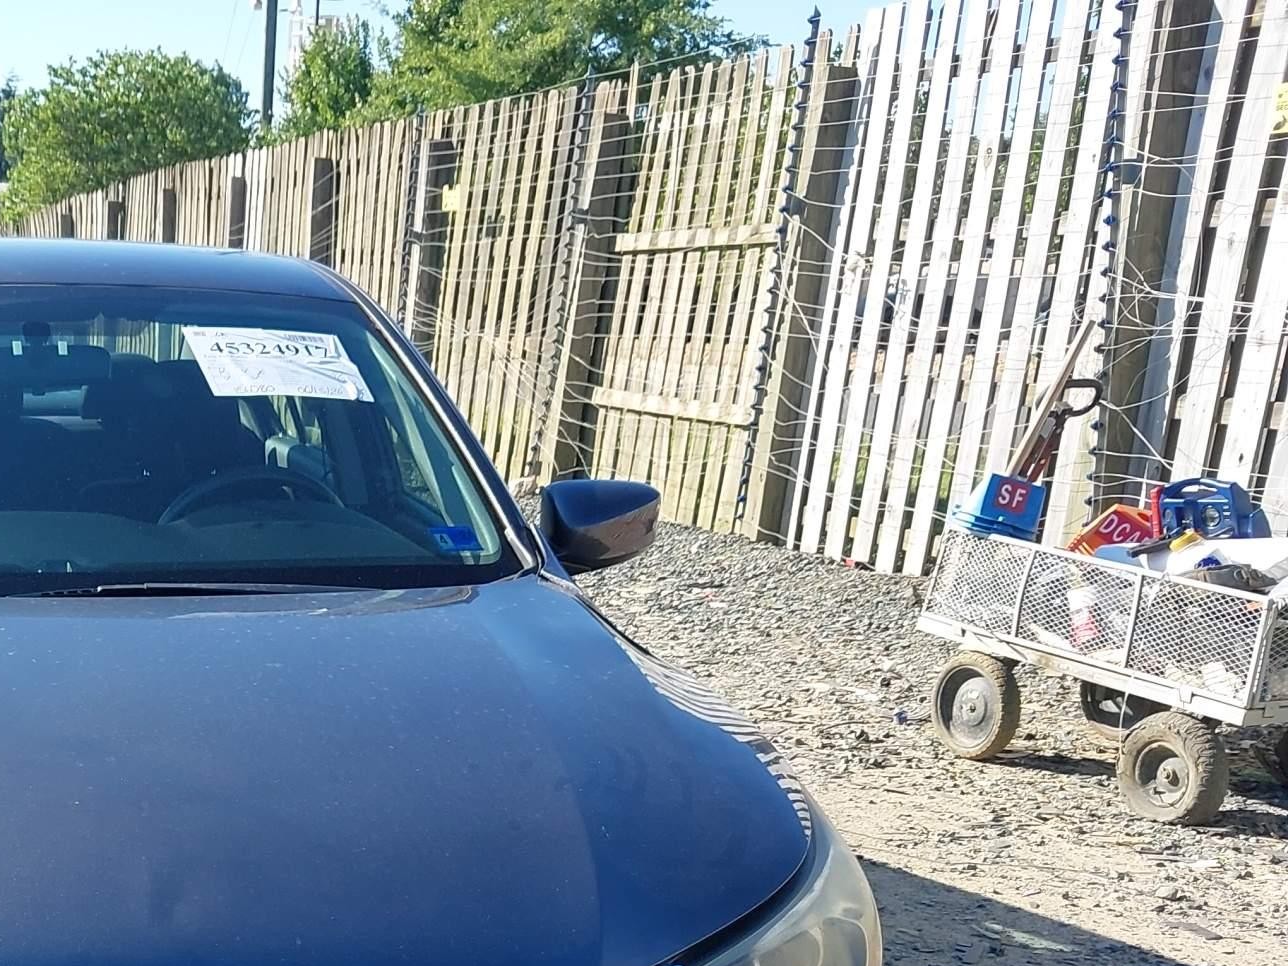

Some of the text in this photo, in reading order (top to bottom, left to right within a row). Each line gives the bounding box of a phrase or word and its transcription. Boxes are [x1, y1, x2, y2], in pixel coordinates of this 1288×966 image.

[209, 341, 329, 359] 45324917
[998, 484, 1027, 508] SF
[1098, 513, 1151, 545] DCA
